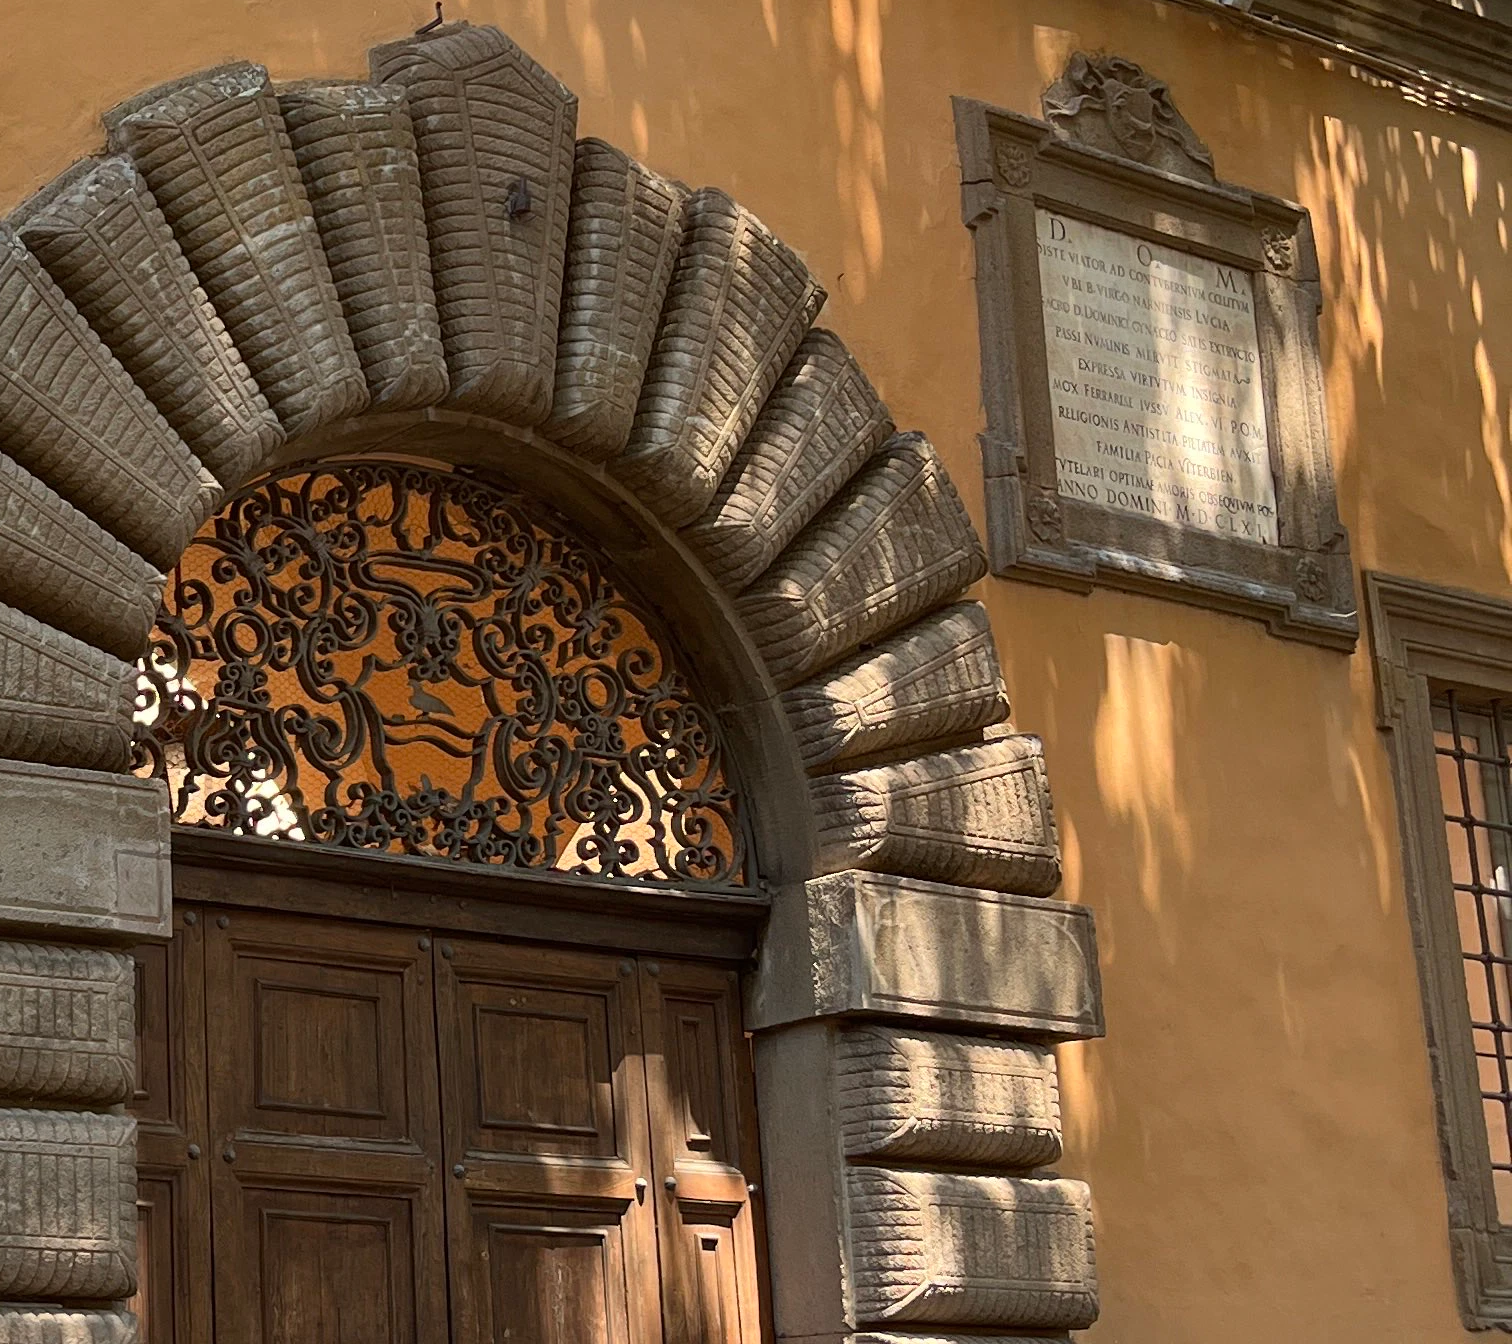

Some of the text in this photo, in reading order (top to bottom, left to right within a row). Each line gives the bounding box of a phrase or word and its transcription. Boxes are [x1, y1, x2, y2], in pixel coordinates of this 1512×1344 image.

[1068, 251, 1108, 274] VIATOR
[1109, 263, 1126, 278] AD
[1062, 274, 1083, 292] VBI
[1055, 325, 1081, 343] PASSI
[1078, 357, 1127, 381] EXPRESSA
[1053, 377, 1079, 395] MOX
[1058, 405, 1120, 432] RELIGIONIS
[1096, 440, 1142, 463] FAMILIA
[1057, 478, 1099, 500] ANNO
